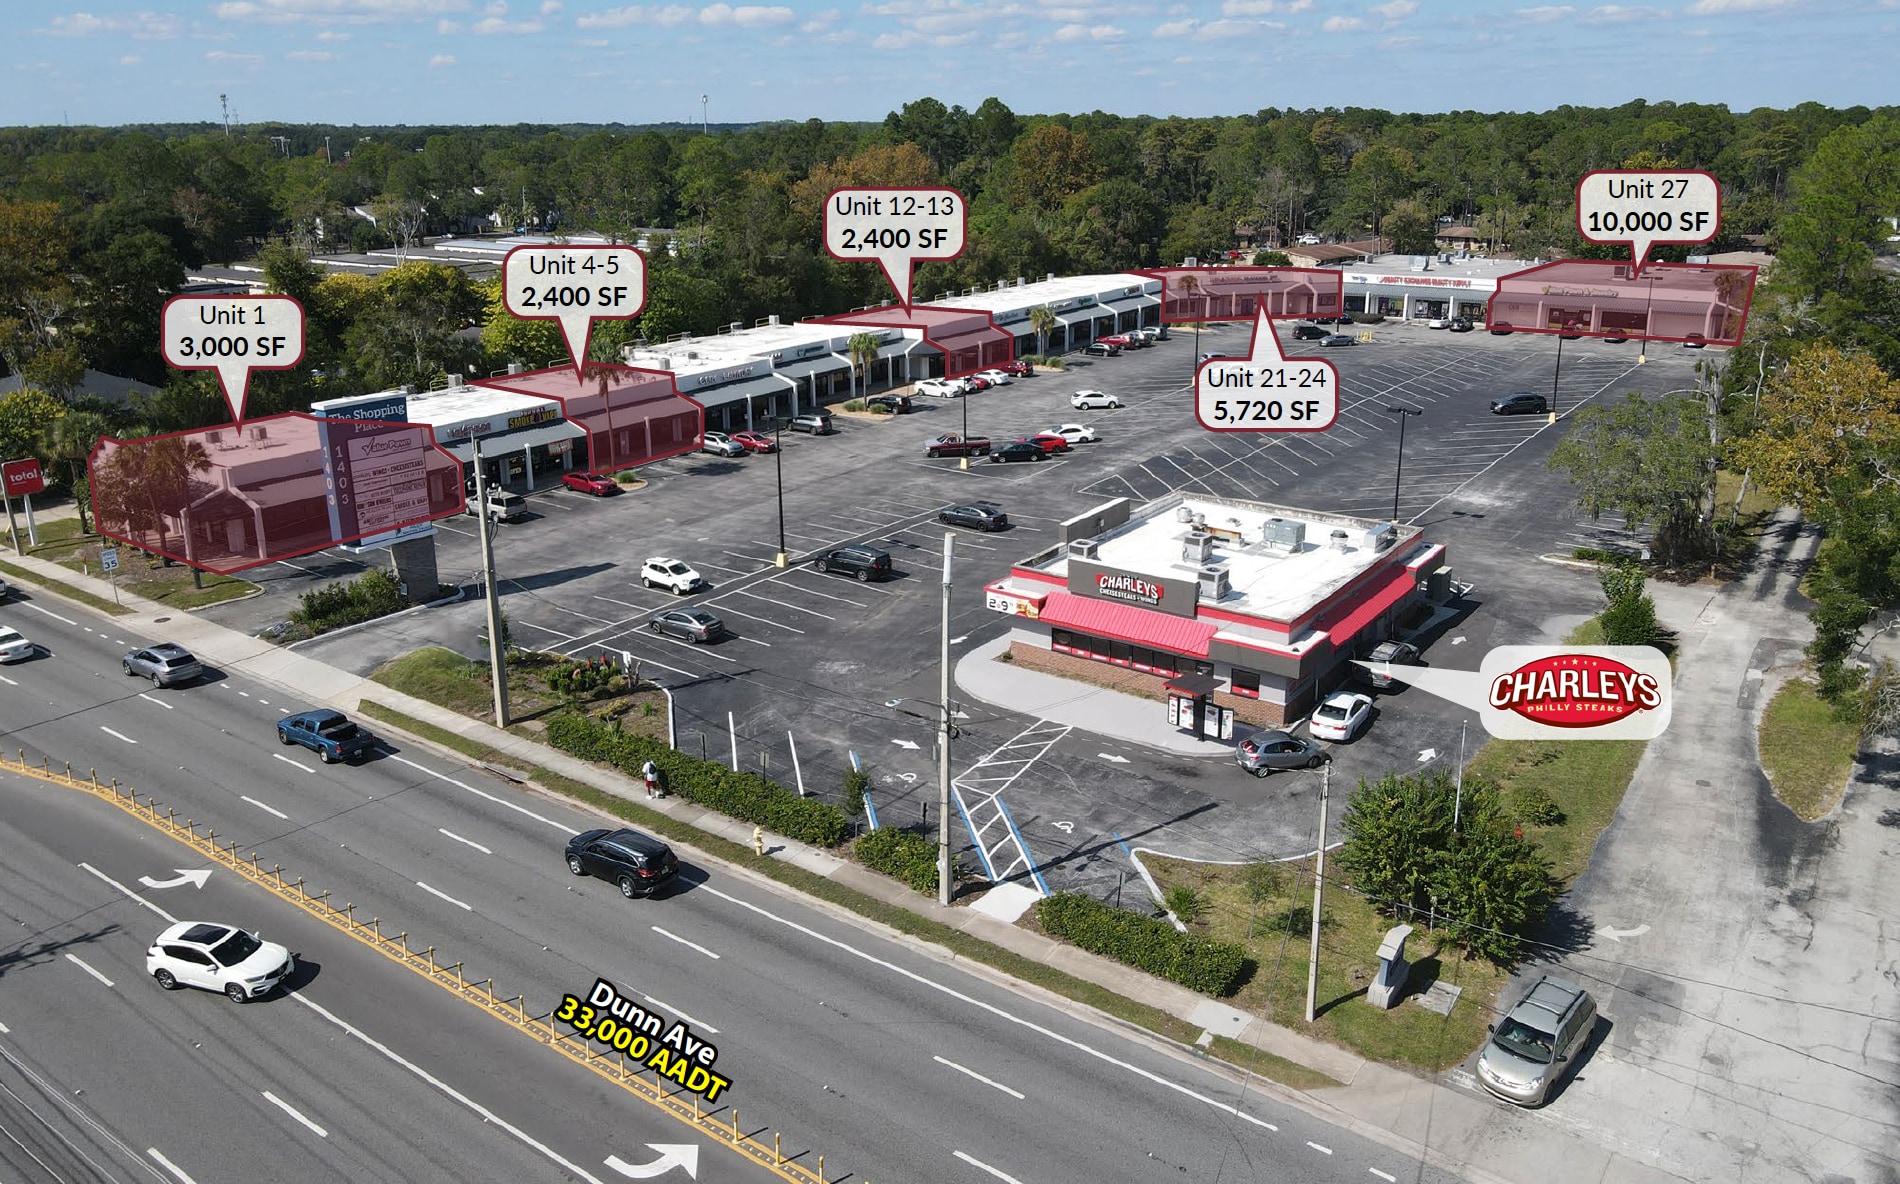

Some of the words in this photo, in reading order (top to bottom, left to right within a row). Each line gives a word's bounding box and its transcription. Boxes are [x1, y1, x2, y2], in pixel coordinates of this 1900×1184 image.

[353, 404, 406, 420] Shopping
[508, 414, 535, 429] SMOKE
[388, 438, 412, 449] Pawn
[10, 468, 38, 483] total
[104, 560, 118, 570] 35
[1099, 576, 1159, 599] CHARLEYS
